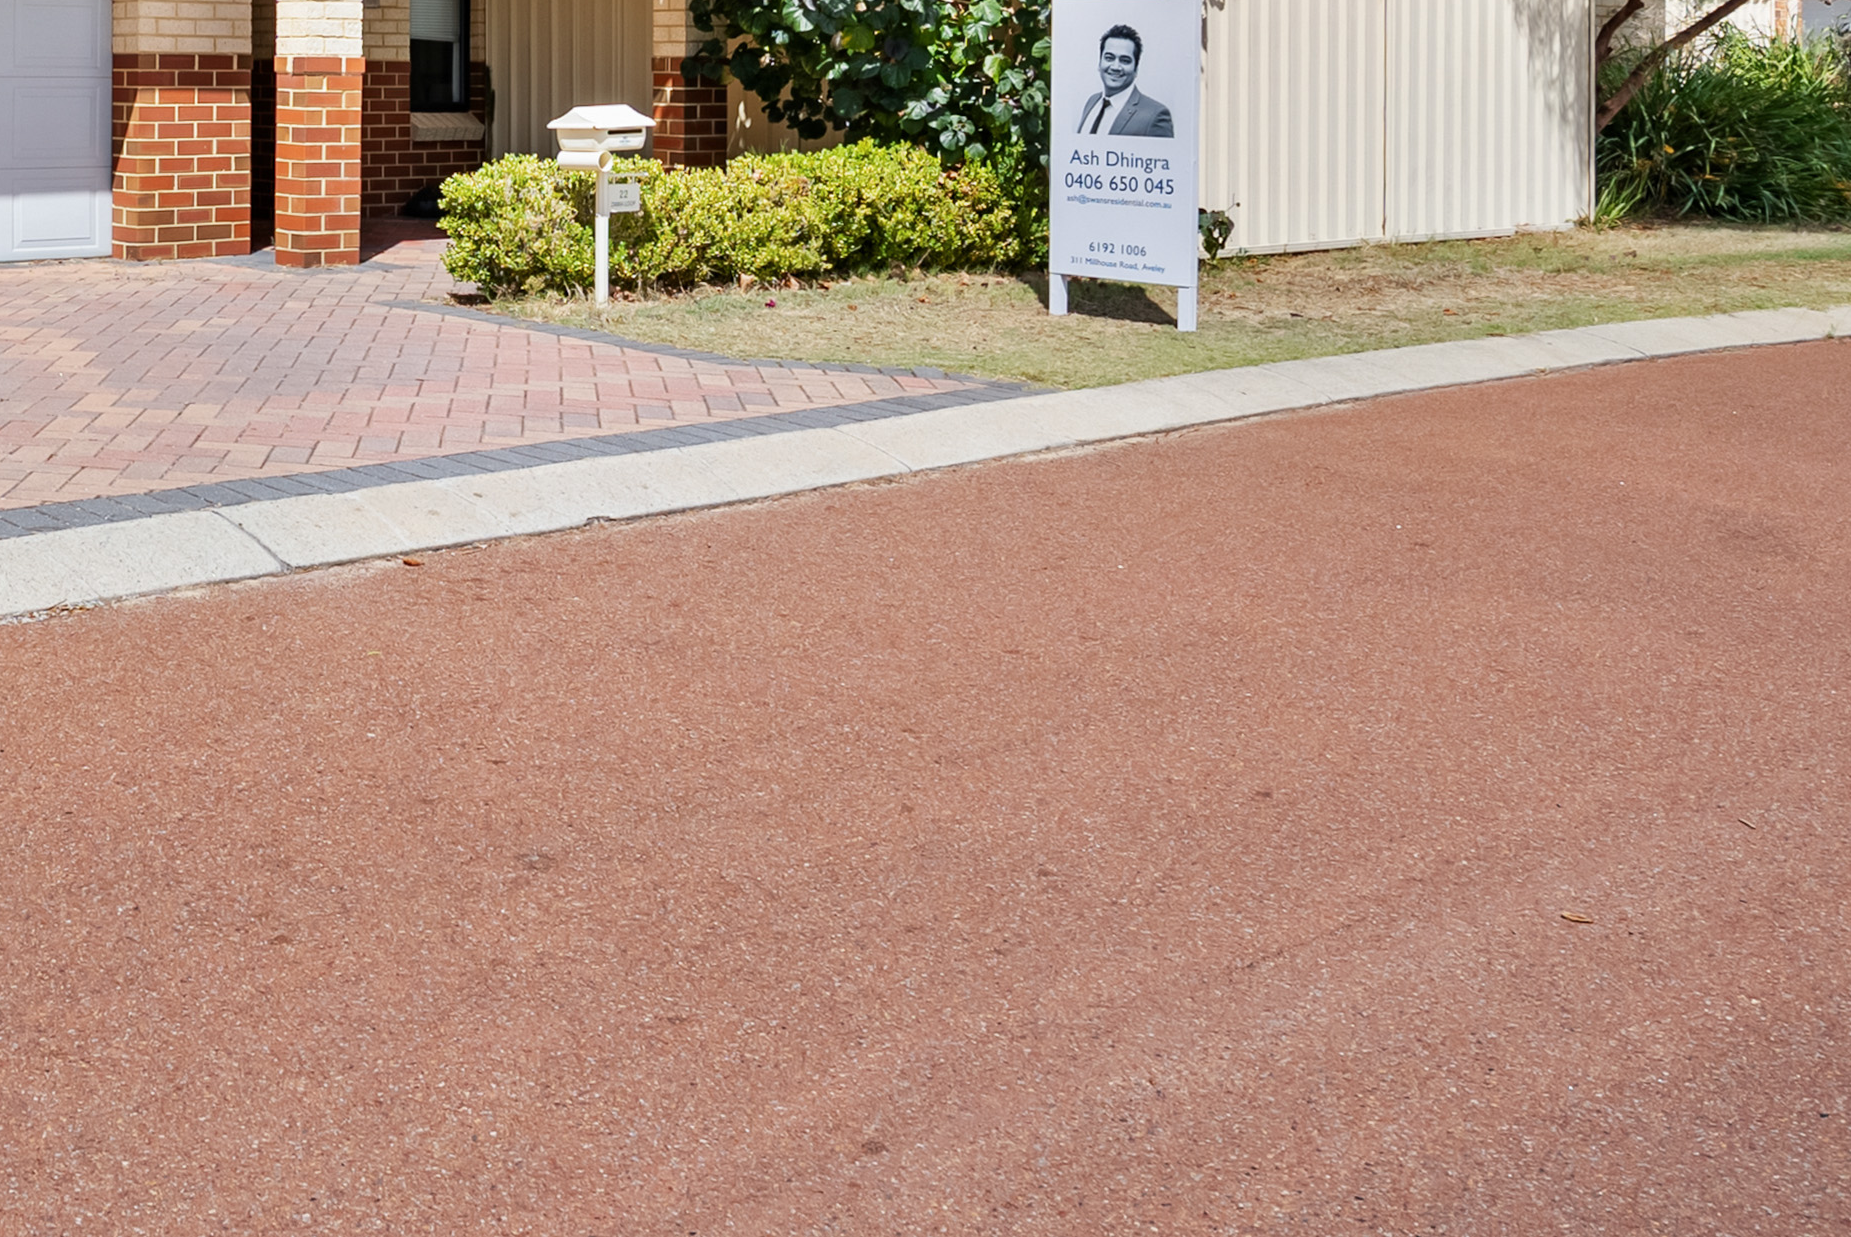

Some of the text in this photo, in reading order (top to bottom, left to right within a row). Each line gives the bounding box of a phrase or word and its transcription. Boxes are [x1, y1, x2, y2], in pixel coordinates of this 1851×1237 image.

[1069, 149, 1170, 174] Ash Dhingra
[1065, 172, 1174, 195] 0406 650 045
[619, 189, 628, 199] 22
[1066, 194, 1172, 209] ash@swansresidential.com.au
[1088, 241, 1147, 257] 6192 1006
